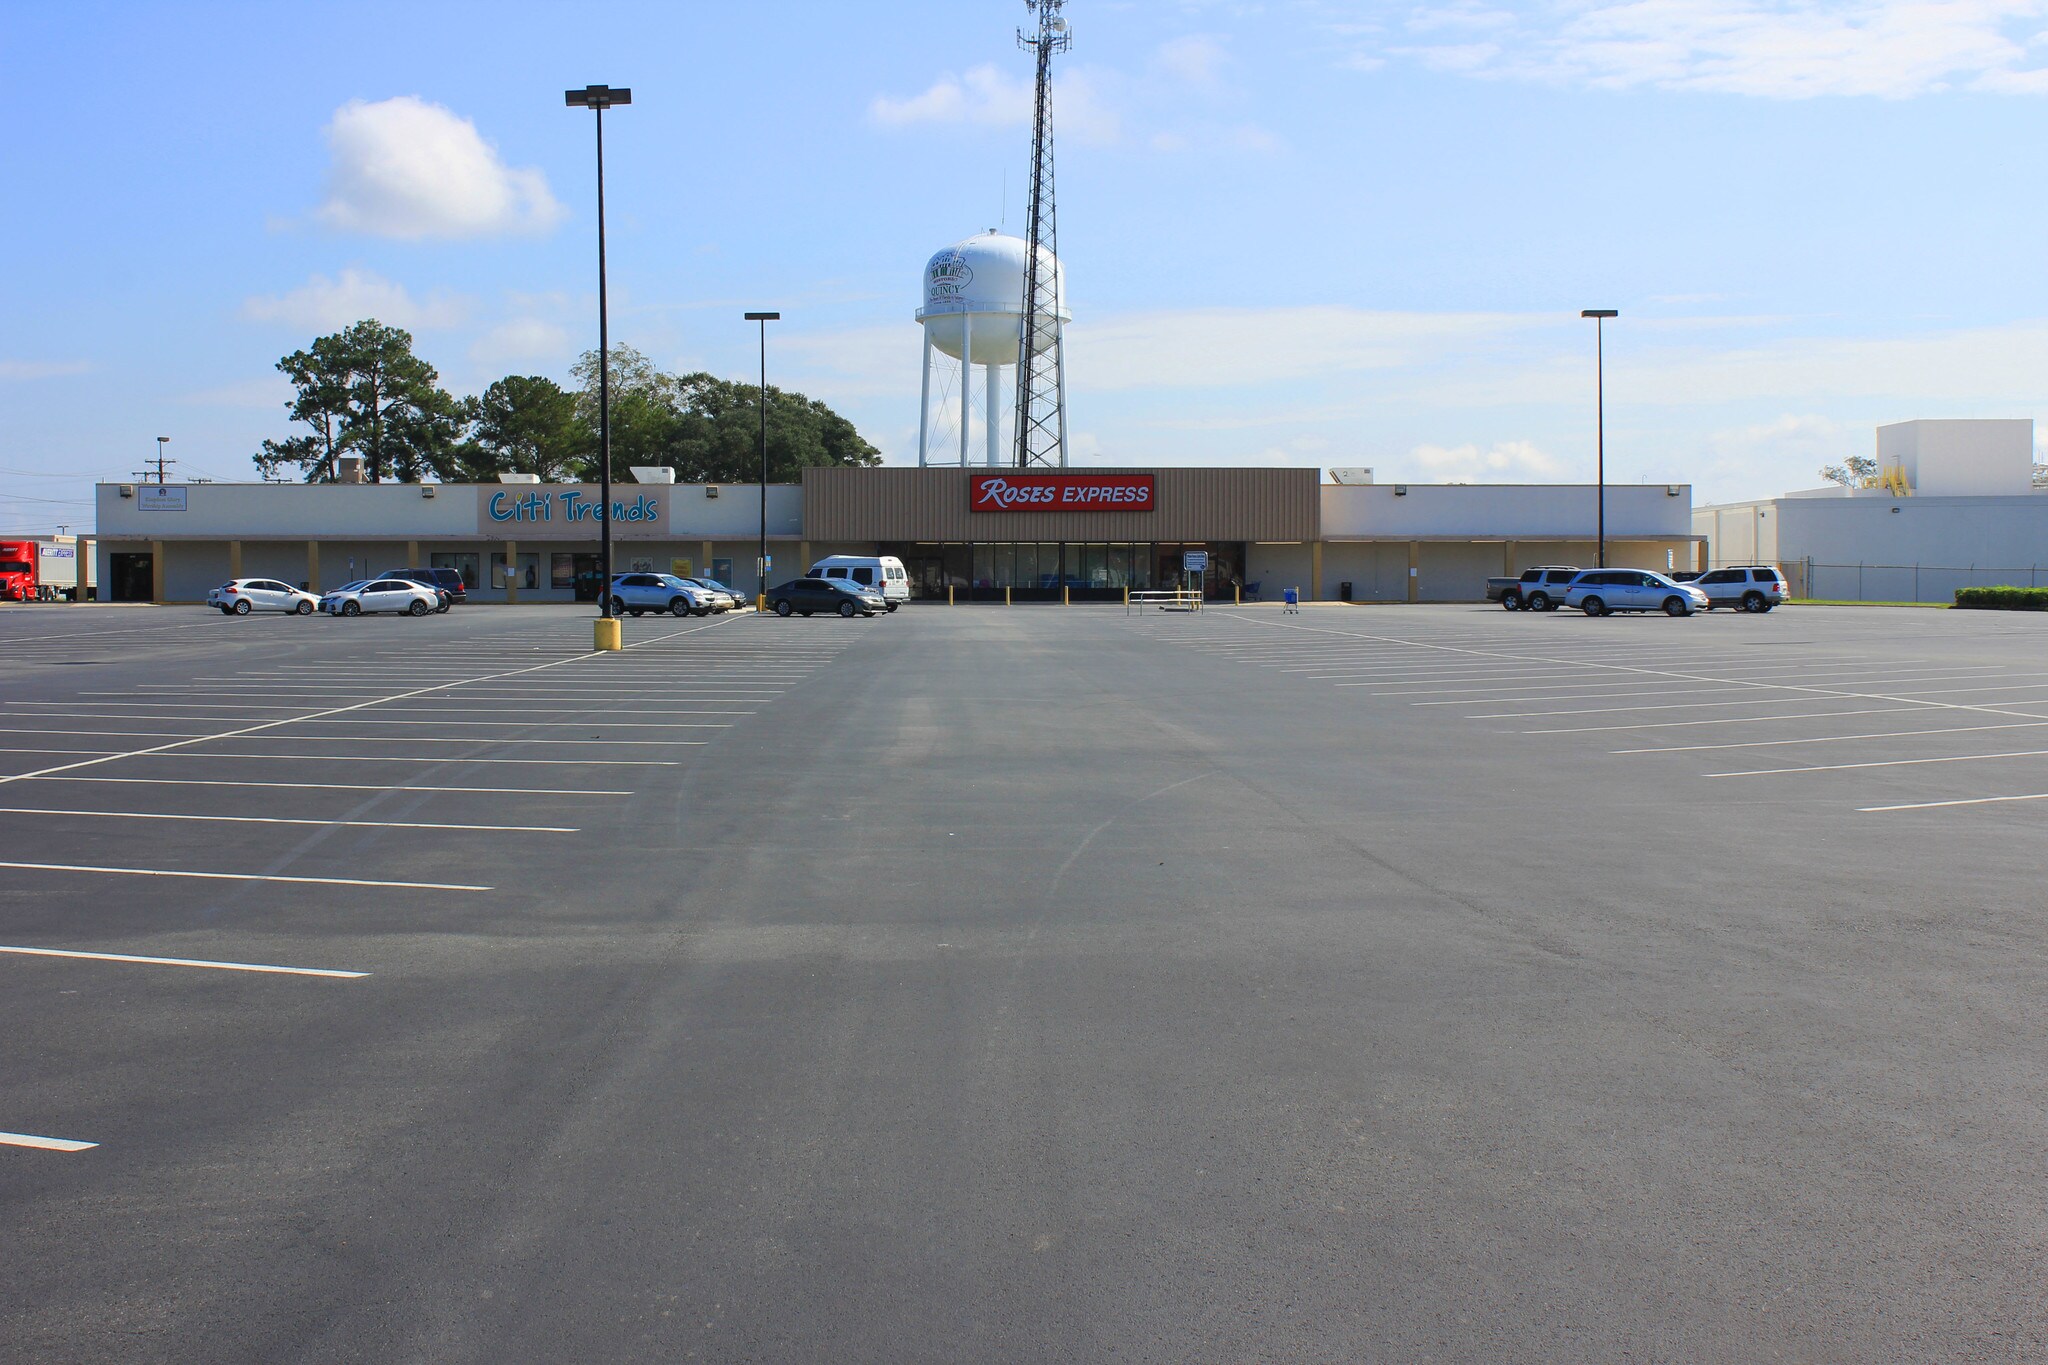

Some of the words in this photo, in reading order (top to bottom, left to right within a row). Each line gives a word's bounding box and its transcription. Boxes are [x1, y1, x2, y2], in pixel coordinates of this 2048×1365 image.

[931, 285, 960, 296] QUINCY
[488, 490, 552, 522] Citi
[559, 490, 658, 522] Trends
[978, 478, 1056, 508] ROSES
[1061, 486, 1149, 502] EXPRESS
